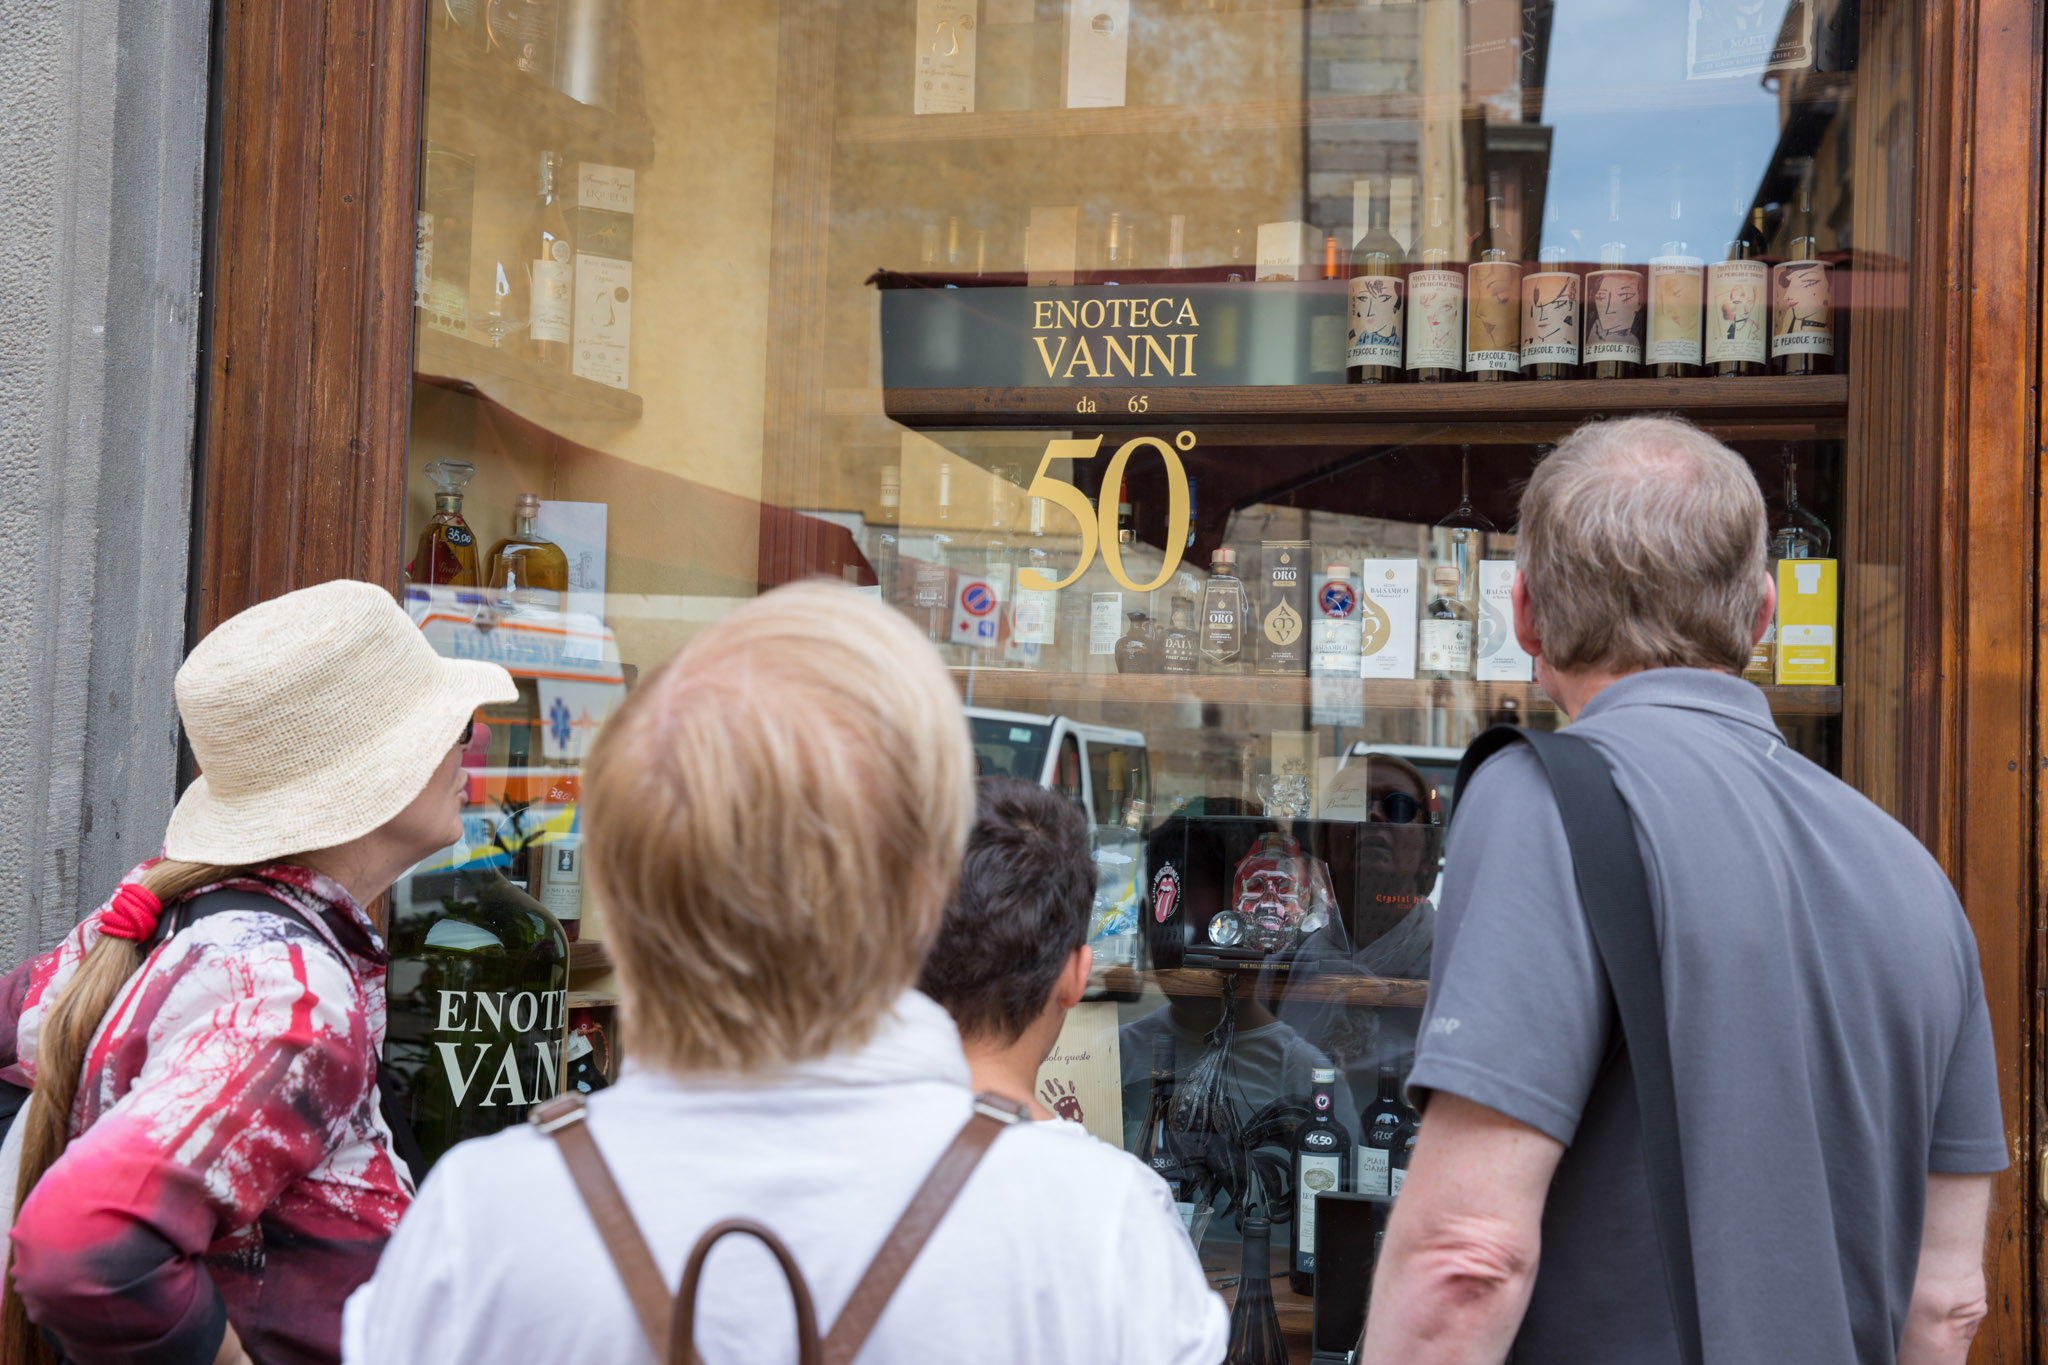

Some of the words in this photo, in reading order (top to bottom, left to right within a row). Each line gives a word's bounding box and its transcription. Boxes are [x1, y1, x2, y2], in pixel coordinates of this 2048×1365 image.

[1032, 297, 1199, 329] ENOTECA
[1032, 334, 1198, 379] VANNI
[1076, 396, 1097, 414] da
[1127, 395, 1149, 413] 65
[1017, 430, 1197, 592] 50°
[448, 527, 472, 544] 35.00
[1272, 570, 1297, 581] ORO
[1209, 613, 1234, 624] ORO
[1376, 893, 1409, 904] Crystal
[433, 989, 567, 1033] ENOTE
[1064, 1050, 1091, 1065] queste
[433, 1038, 564, 1108] VAN
[1306, 1134, 1333, 1146] 16.50
[1363, 1163, 1389, 1173] CIAMP
[1366, 1156, 1386, 1166] PIAN
